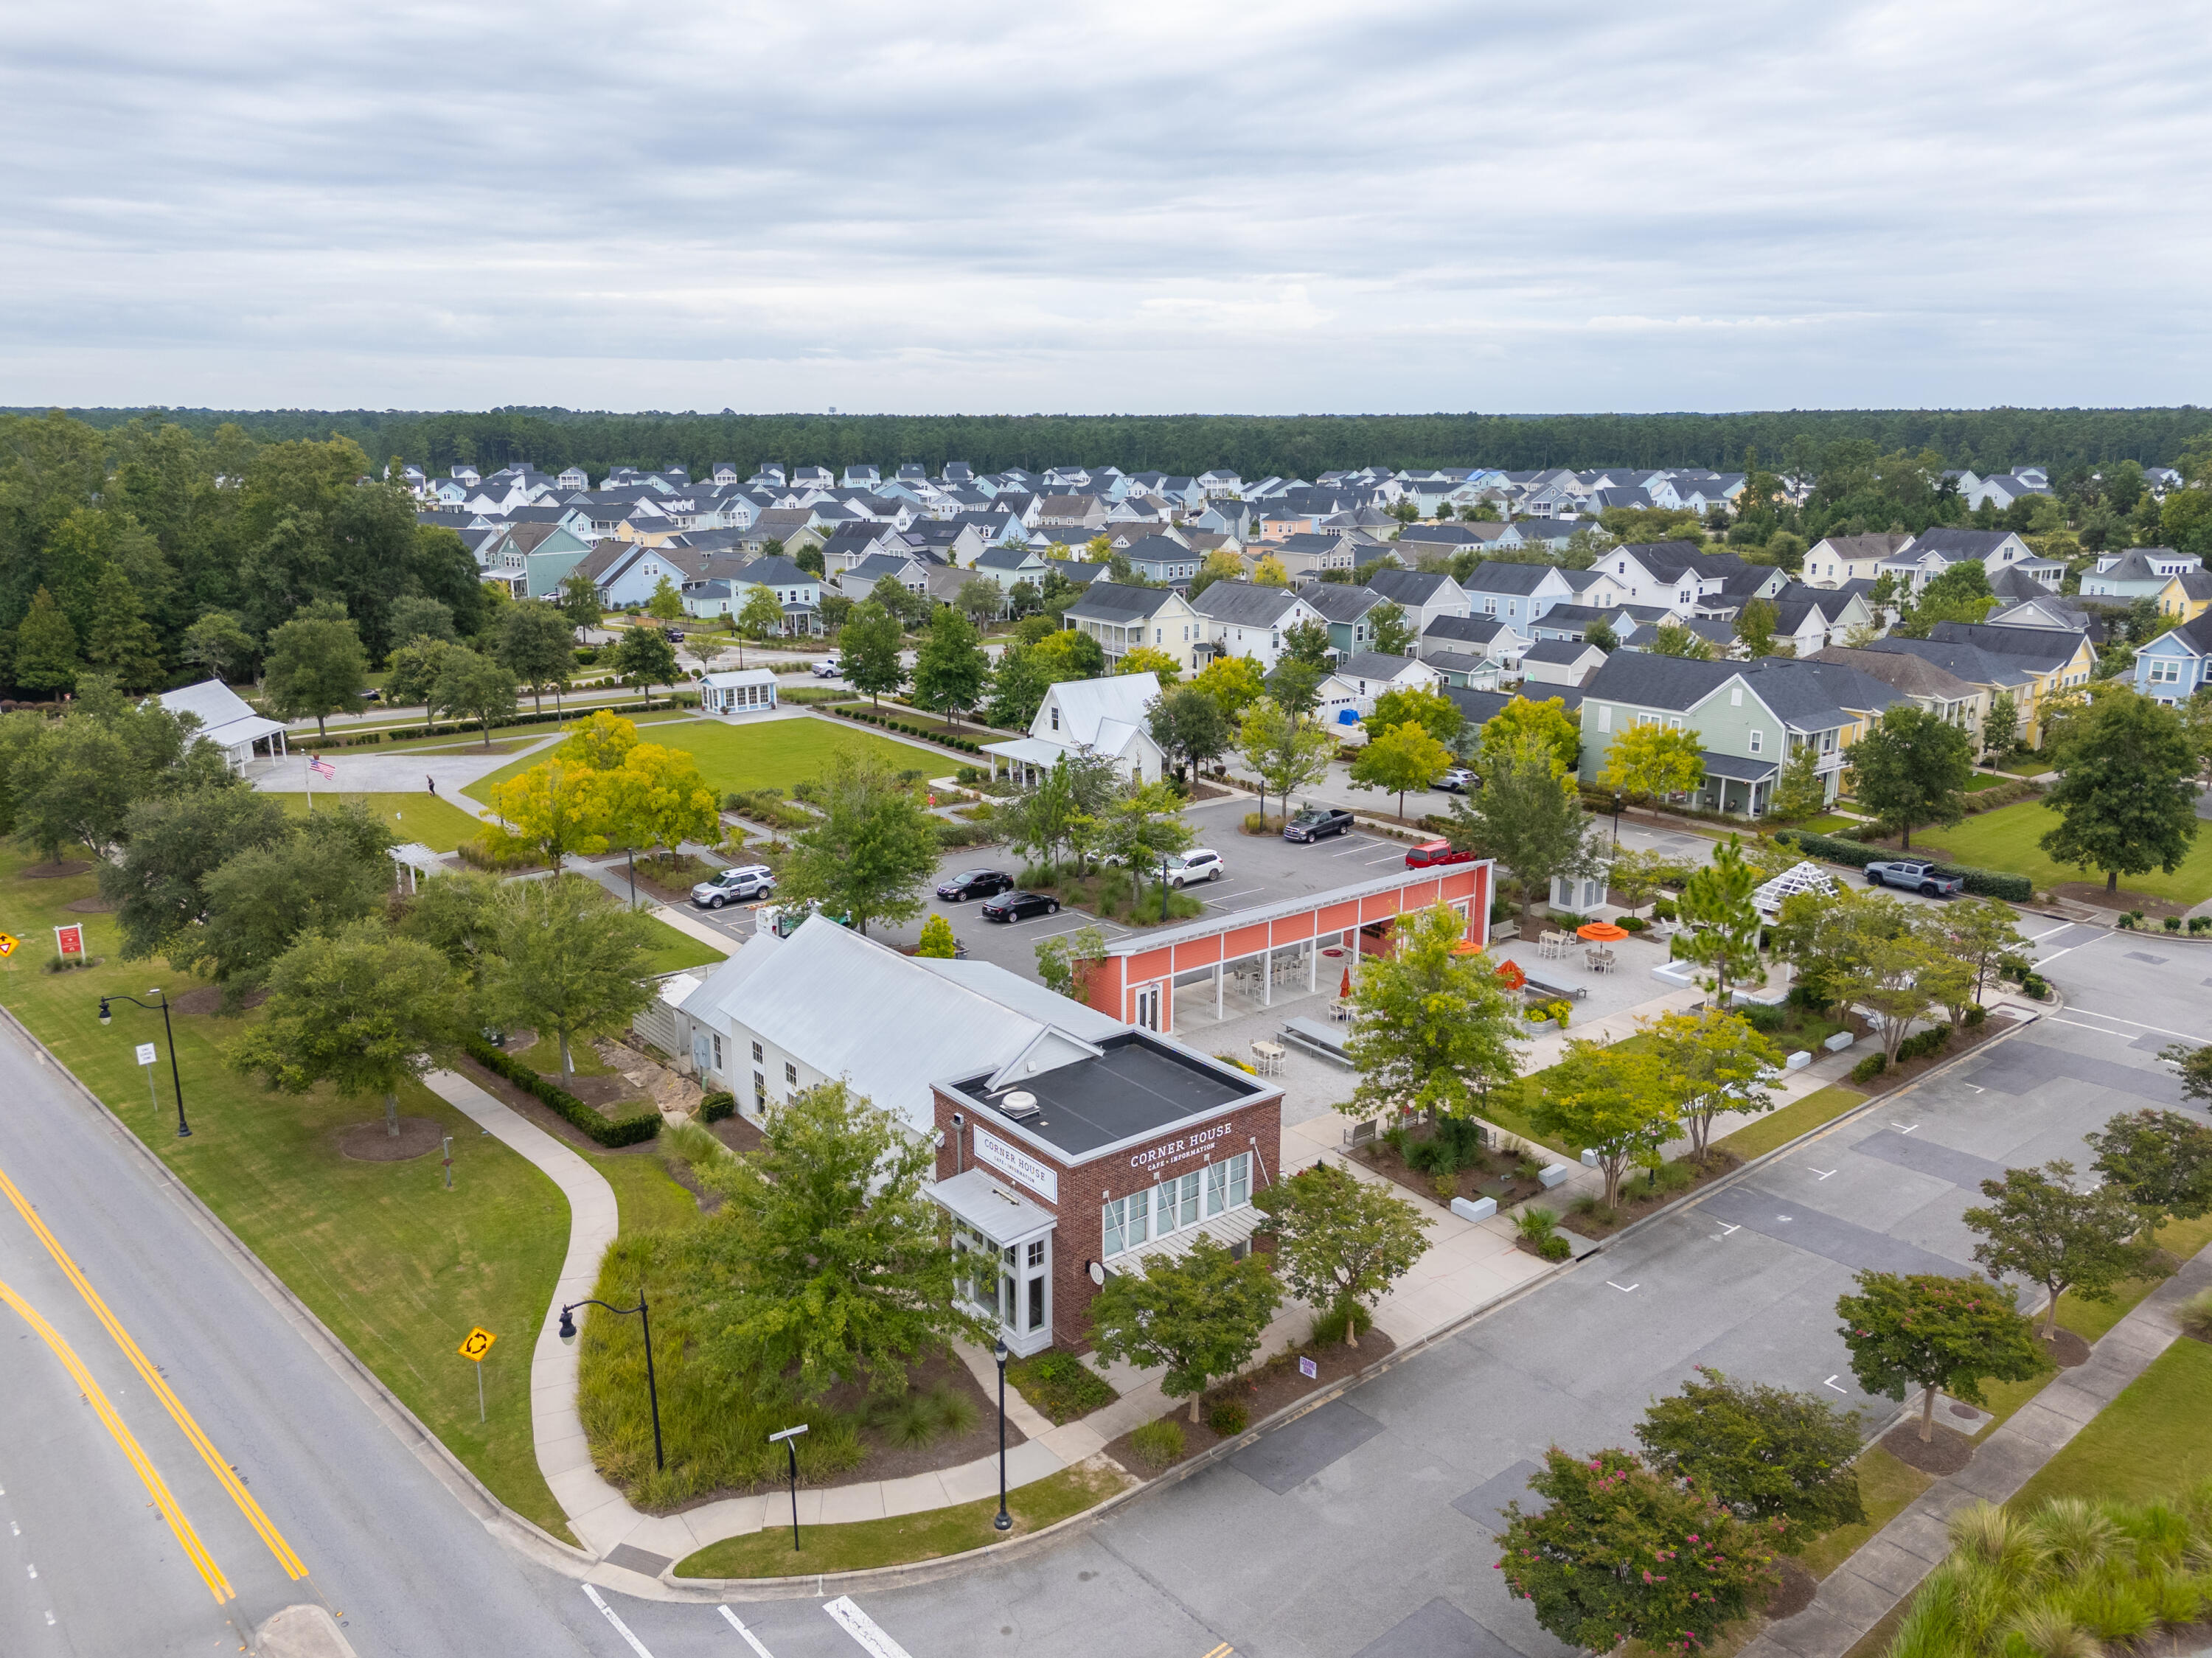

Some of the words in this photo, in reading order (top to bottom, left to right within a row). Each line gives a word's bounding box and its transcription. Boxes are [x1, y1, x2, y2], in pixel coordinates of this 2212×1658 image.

[984, 1138, 1015, 1164] CORNER
[1018, 1158, 1045, 1181] HOUSE
[1130, 1140, 1185, 1167] CORNER
[1189, 1123, 1231, 1147] HOUSE
[1147, 1160, 1165, 1171] CAFE
[1170, 1142, 1215, 1163] INFORMATION
